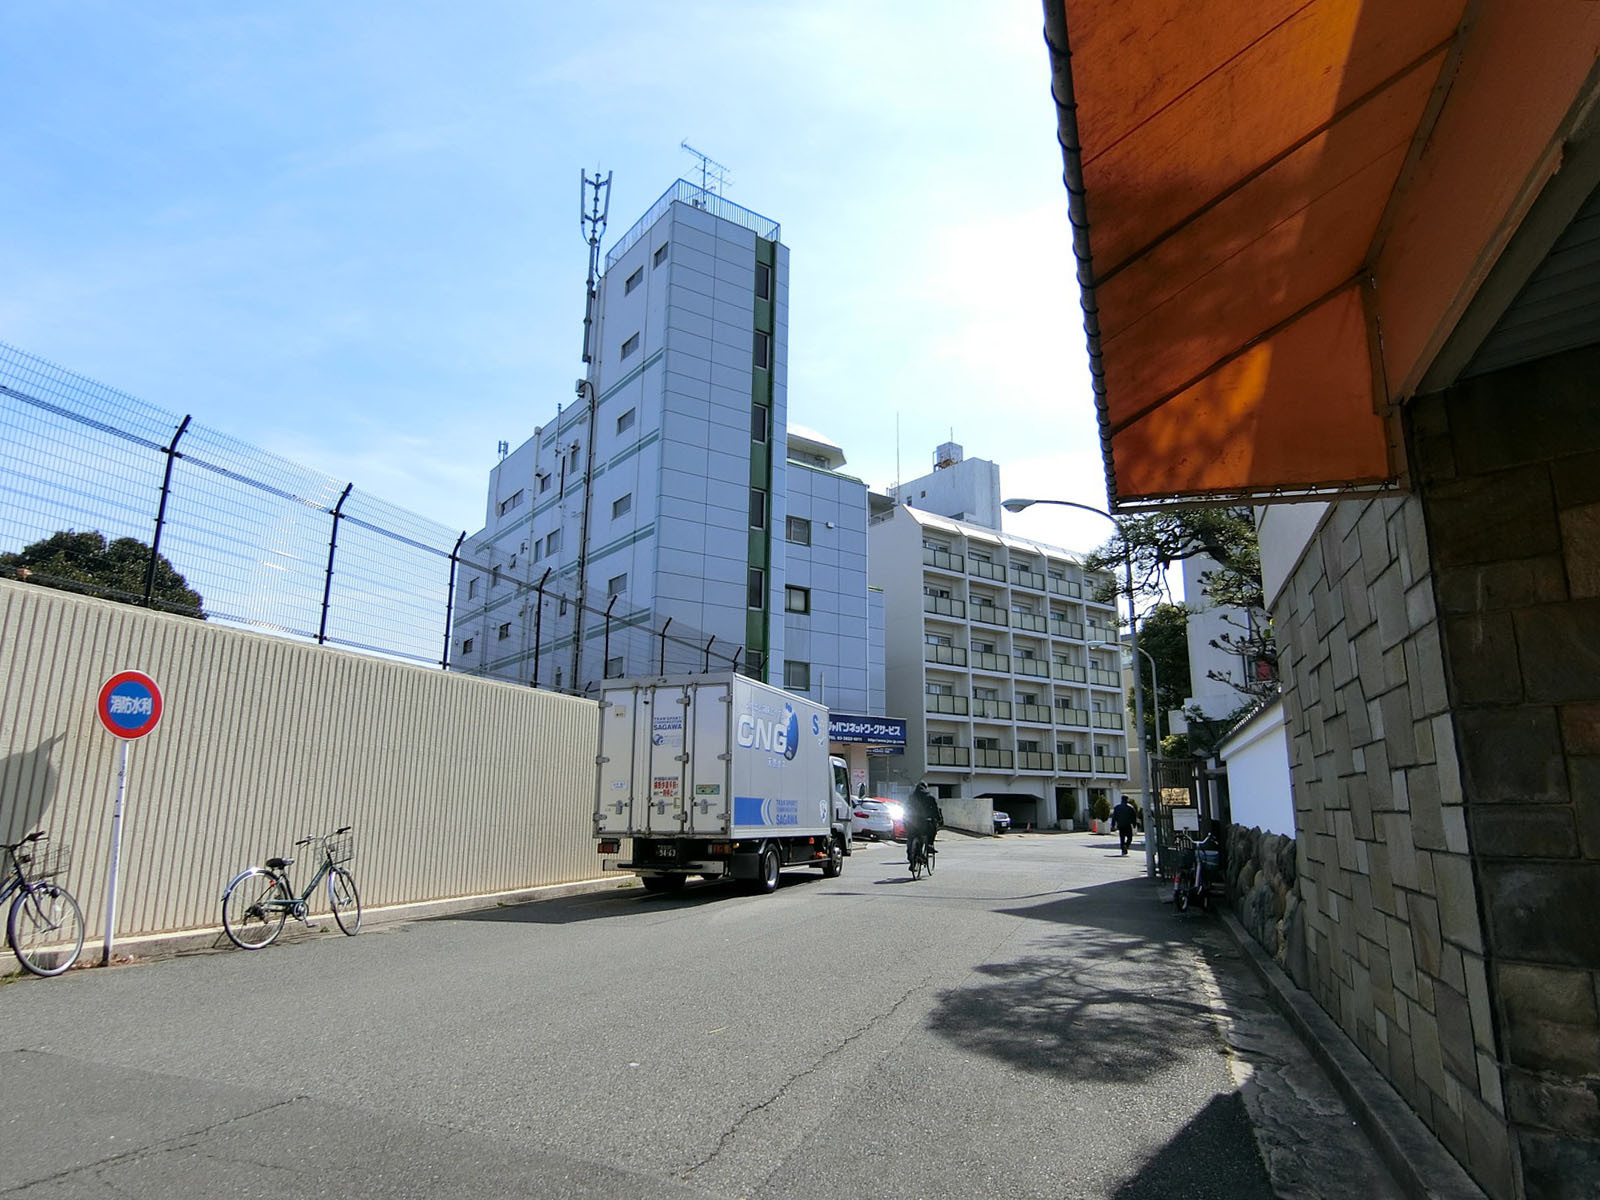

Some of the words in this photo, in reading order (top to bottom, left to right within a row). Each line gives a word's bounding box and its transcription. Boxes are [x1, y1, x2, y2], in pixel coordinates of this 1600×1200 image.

[110, 695, 152, 715] 消防水利
[738, 714, 788, 755] CNG
[776, 814, 798, 825] SAGAWA
